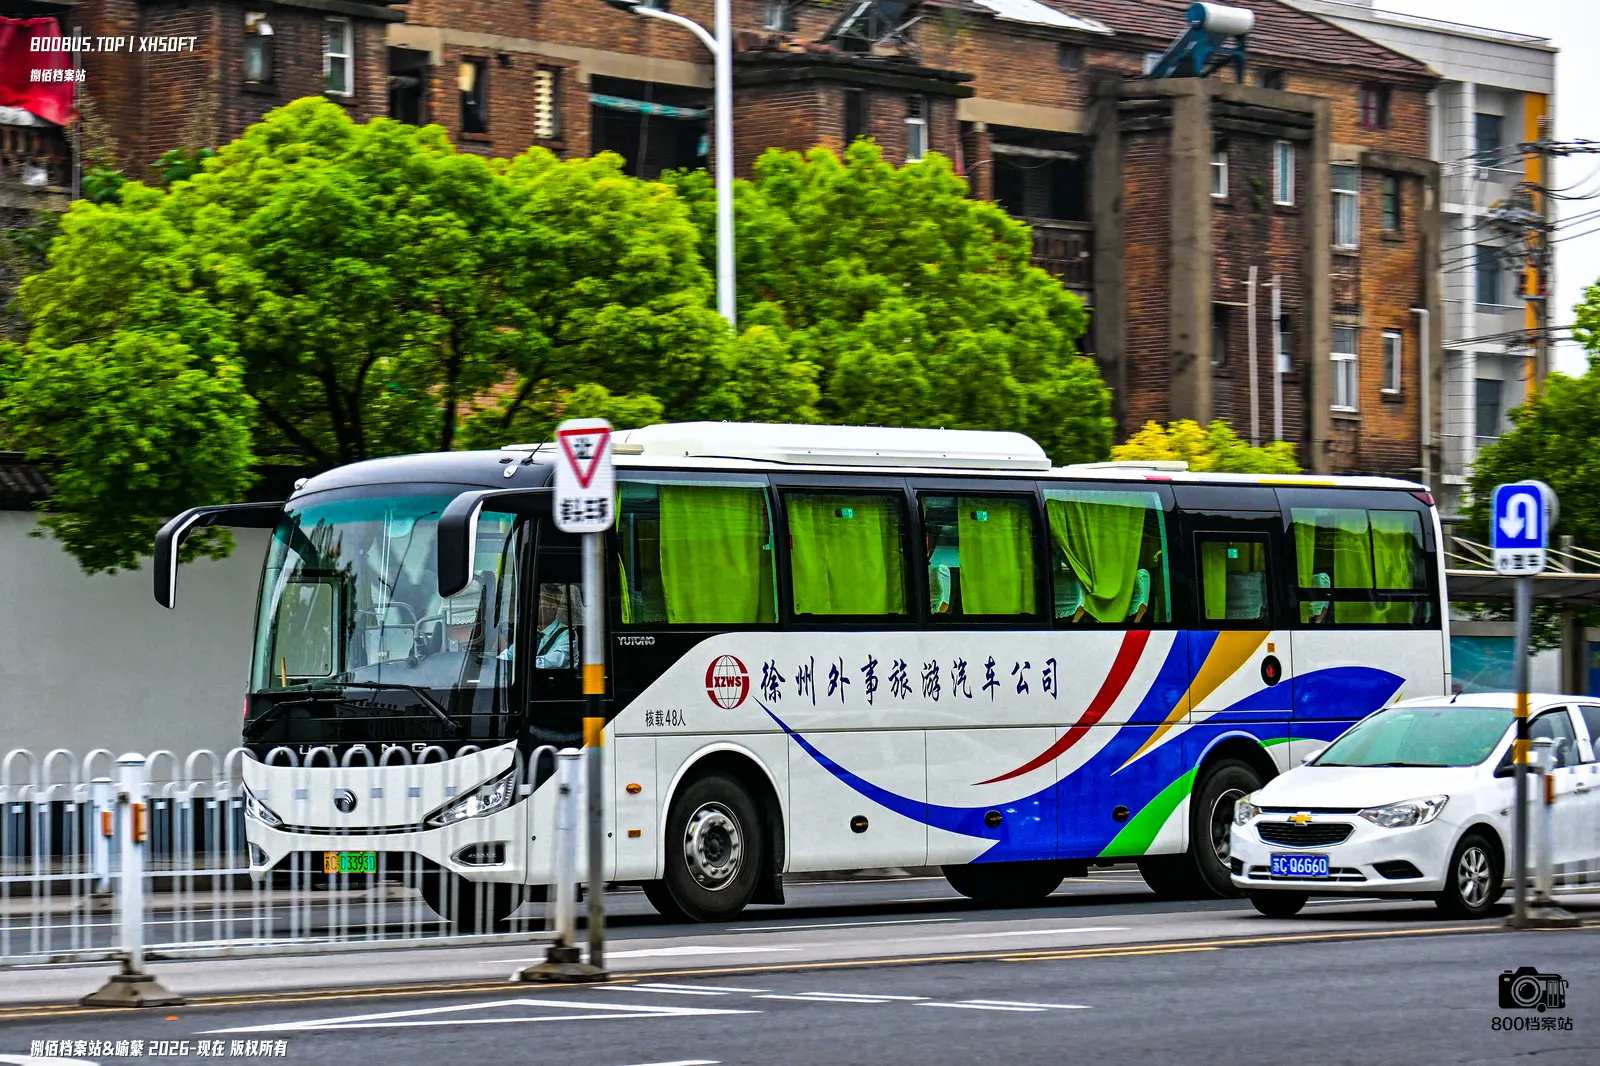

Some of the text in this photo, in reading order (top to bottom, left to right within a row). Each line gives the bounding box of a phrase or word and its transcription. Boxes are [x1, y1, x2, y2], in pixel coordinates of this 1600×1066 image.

[617, 636, 655, 646] YUTONG
[713, 676, 742, 688] XZWS
[760, 654, 1058, 706] 徐州外事旅游汽车公司
[645, 709, 687, 727] 核载48人
